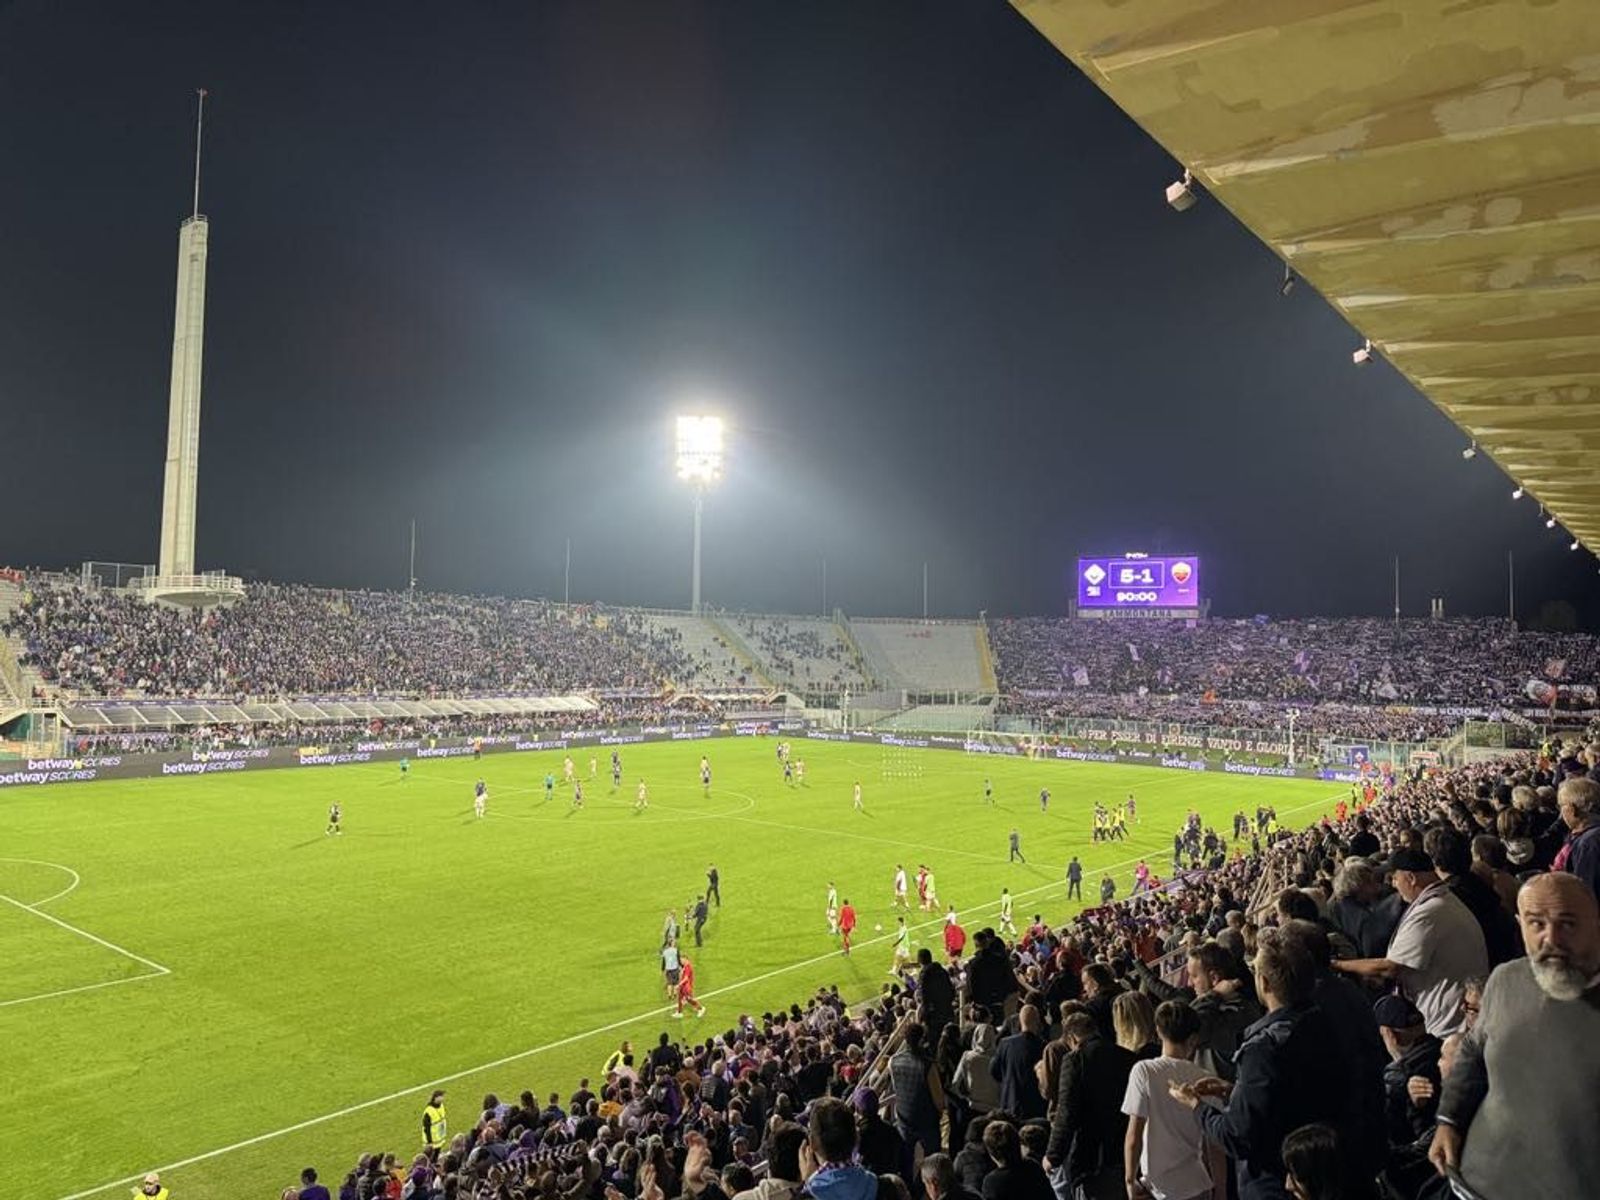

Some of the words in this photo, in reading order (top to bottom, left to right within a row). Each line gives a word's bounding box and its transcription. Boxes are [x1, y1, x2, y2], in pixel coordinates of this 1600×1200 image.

[1120, 568, 1154, 583] 5-1
[1116, 591, 1157, 602] 90:00
[1146, 732, 1157, 743] DI
[1208, 738, 1241, 750] VANTO
[192, 750, 233, 761] btway
[417, 747, 449, 758] betway
[1056, 749, 1087, 761] betway
[28, 758, 77, 770] betway
[300, 754, 337, 765] betway
[163, 762, 207, 774] betway
[1225, 761, 1261, 776] betway
